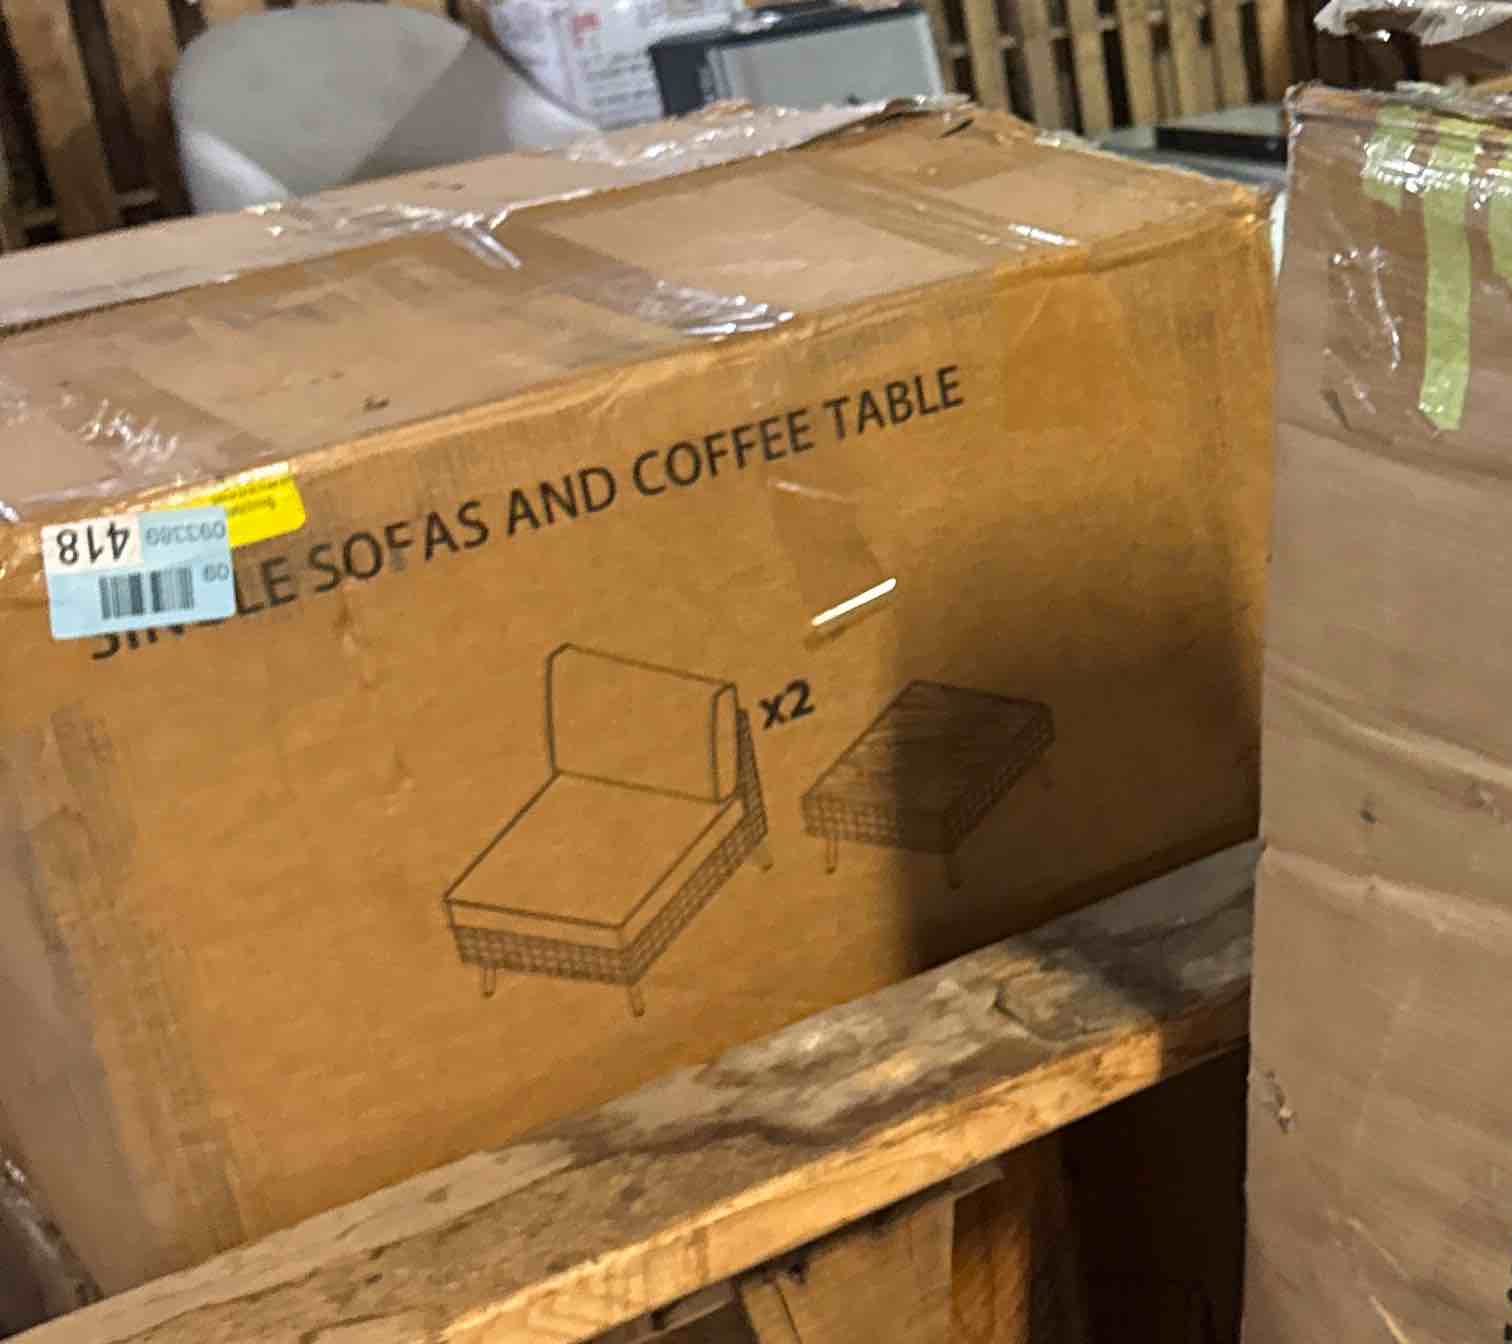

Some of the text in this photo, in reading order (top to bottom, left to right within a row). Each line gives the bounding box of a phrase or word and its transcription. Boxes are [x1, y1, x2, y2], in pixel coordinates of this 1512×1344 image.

[306, 364, 966, 594] SOFAS AND COFFEE TABLE
[56, 521, 131, 567] 418
[758, 678, 816, 731] x2
